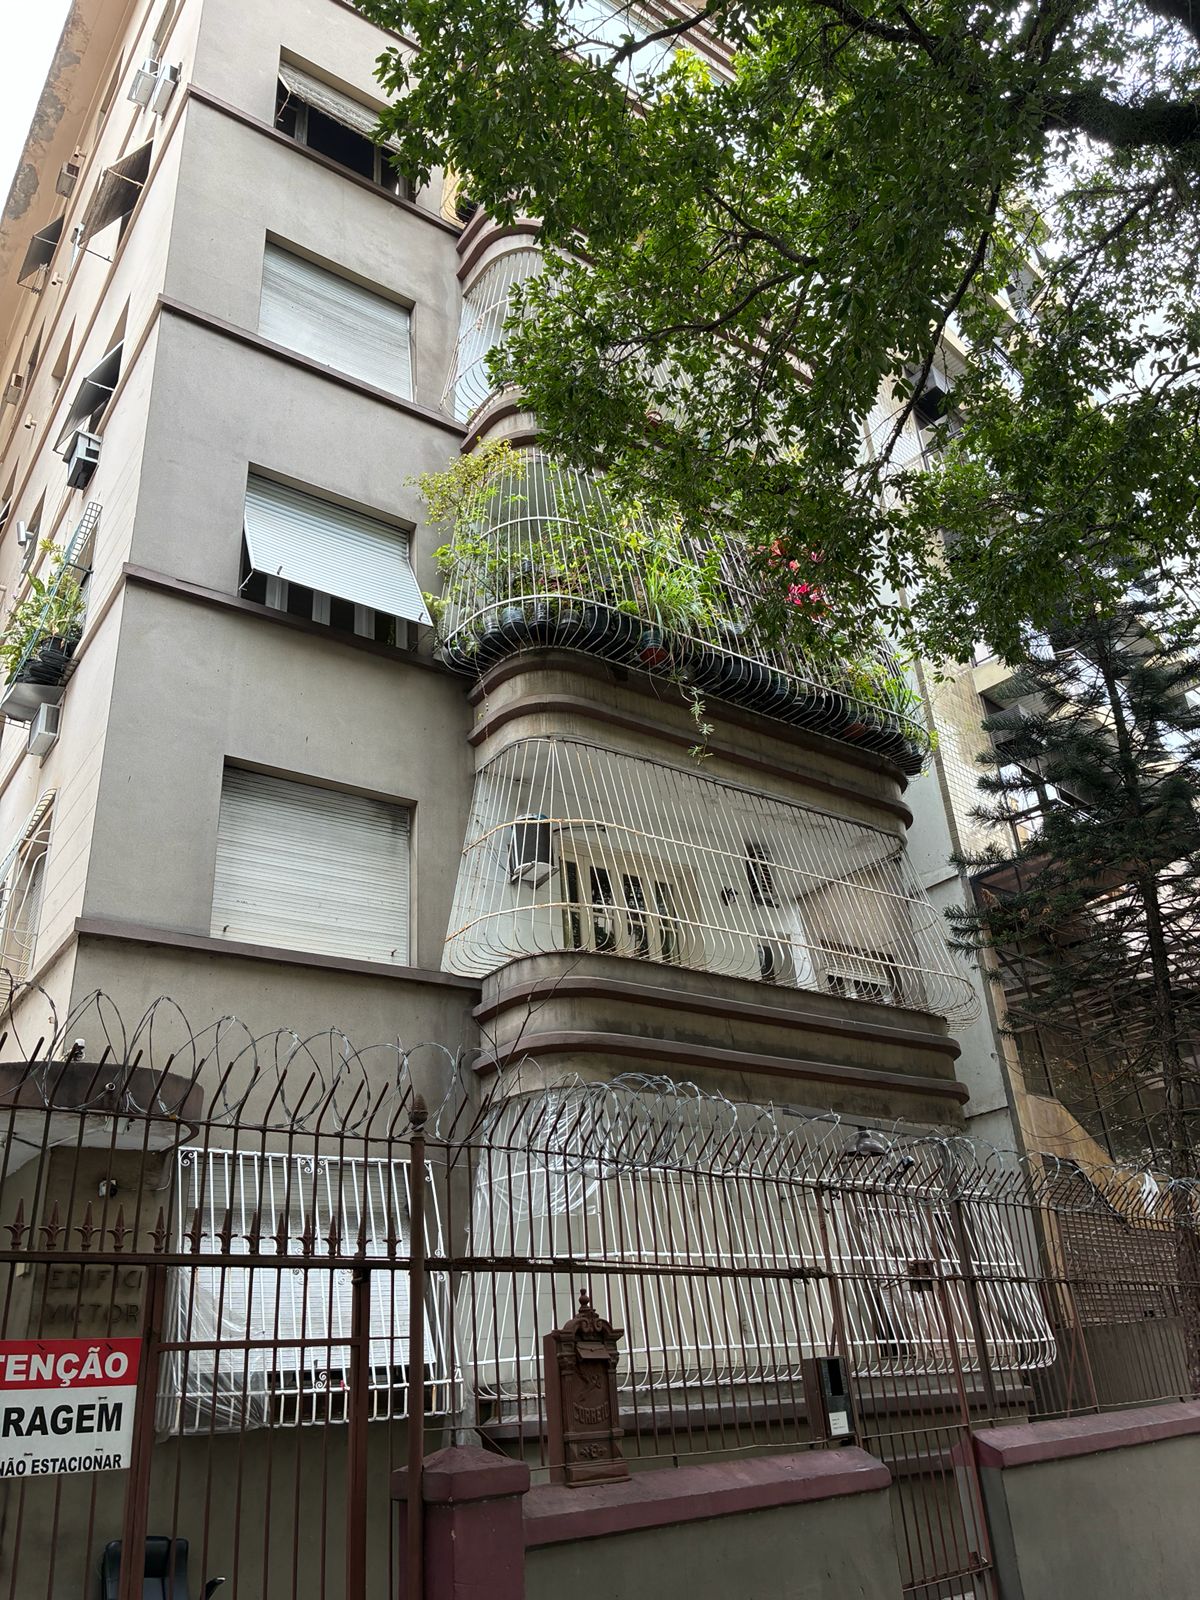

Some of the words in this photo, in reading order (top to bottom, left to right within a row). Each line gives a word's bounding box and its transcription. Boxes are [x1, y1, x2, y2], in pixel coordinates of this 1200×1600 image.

[49, 1270, 142, 1289] EDIFICI
[0, 1347, 128, 1387] ENÇÃO
[2, 1402, 122, 1437] RAGEM
[31, 1453, 122, 1474] ESTACIONAR
